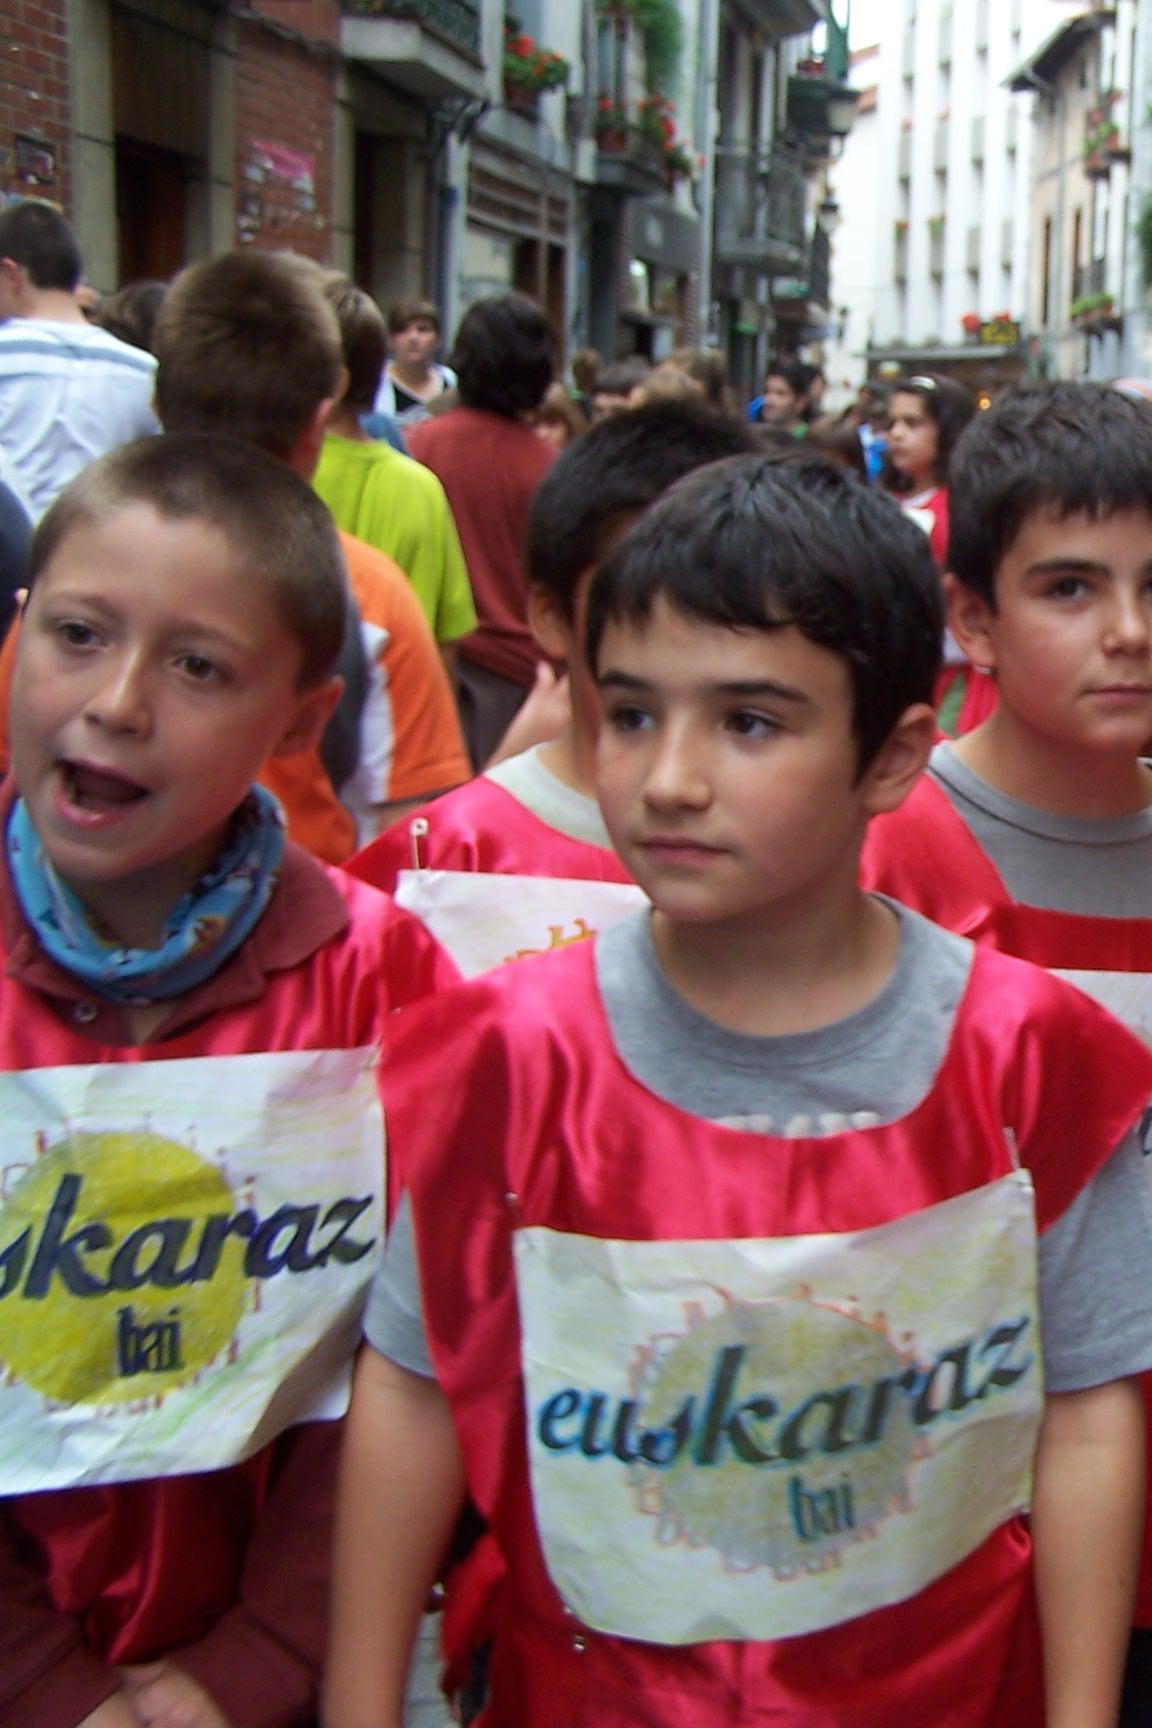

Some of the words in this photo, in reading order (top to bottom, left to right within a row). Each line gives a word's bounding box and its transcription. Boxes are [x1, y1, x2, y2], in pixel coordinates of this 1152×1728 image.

[116, 1304, 184, 1377] bai
[537, 1315, 1034, 1466] euskaraz
[789, 1472, 856, 1543] bai
